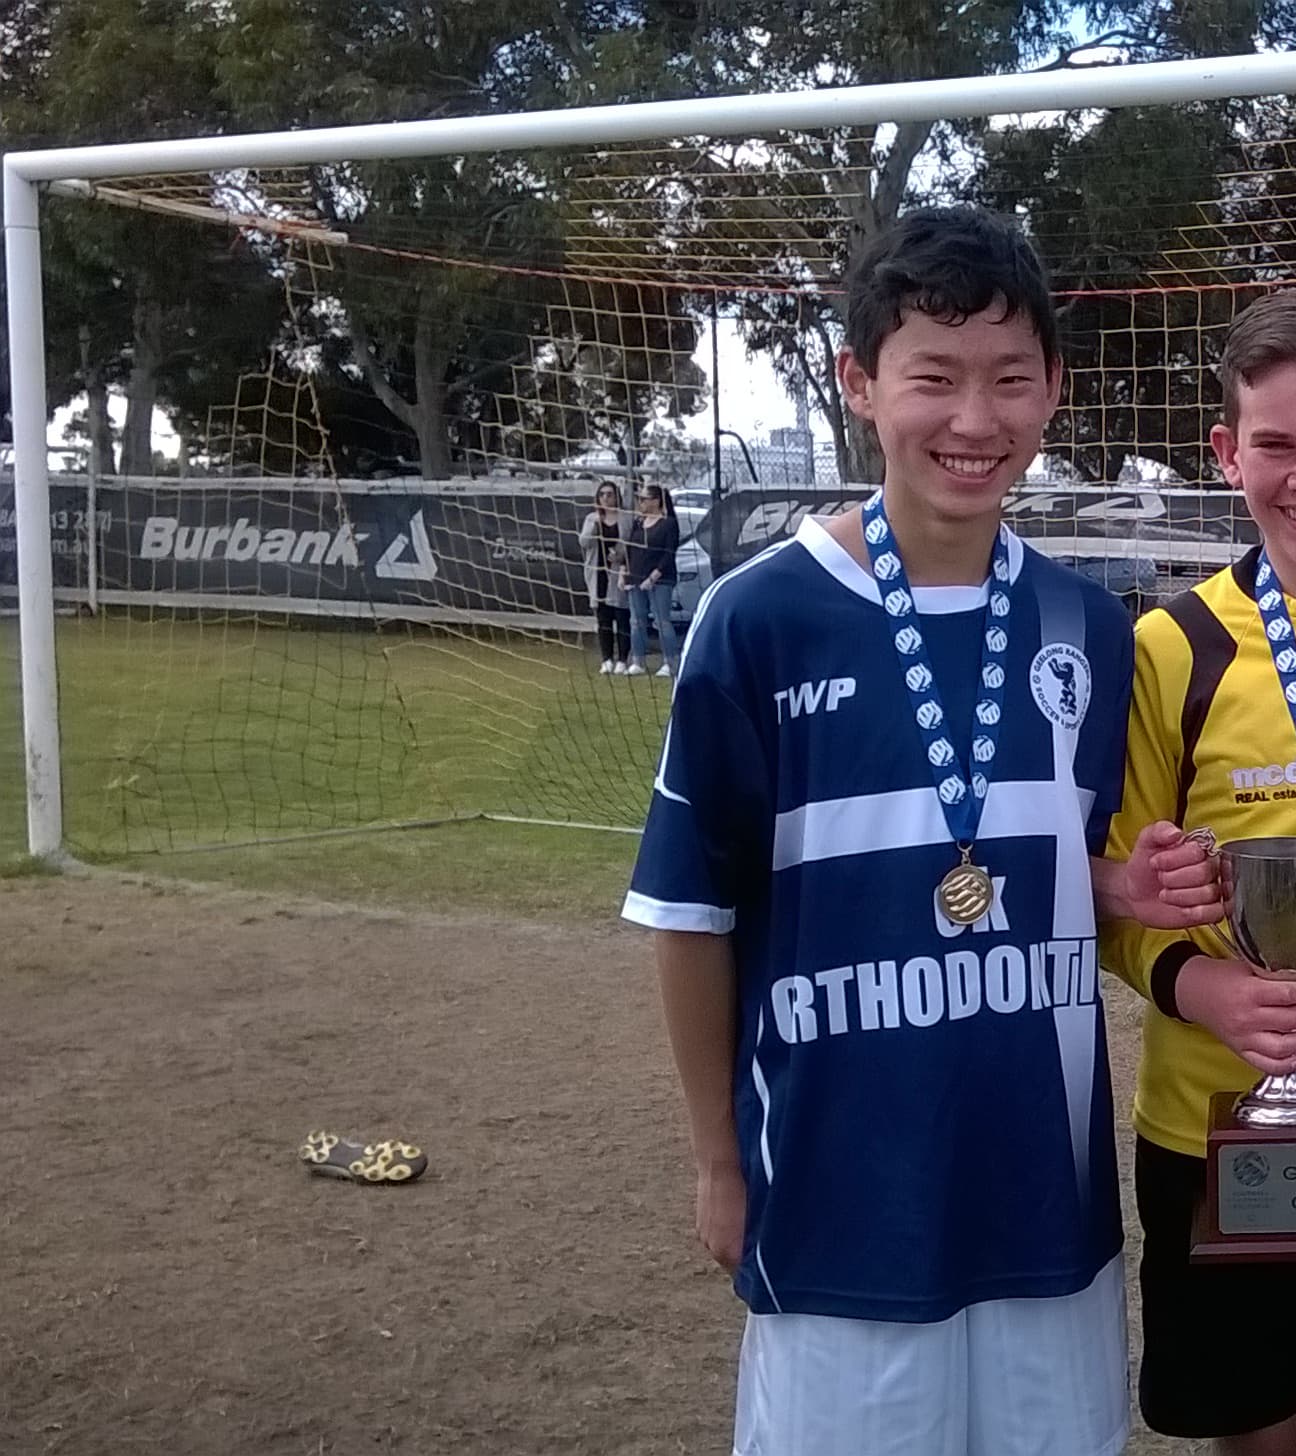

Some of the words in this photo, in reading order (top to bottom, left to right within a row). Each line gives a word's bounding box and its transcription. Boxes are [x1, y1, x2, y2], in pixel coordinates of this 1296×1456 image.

[140, 516, 370, 568] Burbank
[1034, 647, 1063, 672] GEELONG
[773, 677, 857, 726] TWP
[1235, 789, 1270, 804] REAL
